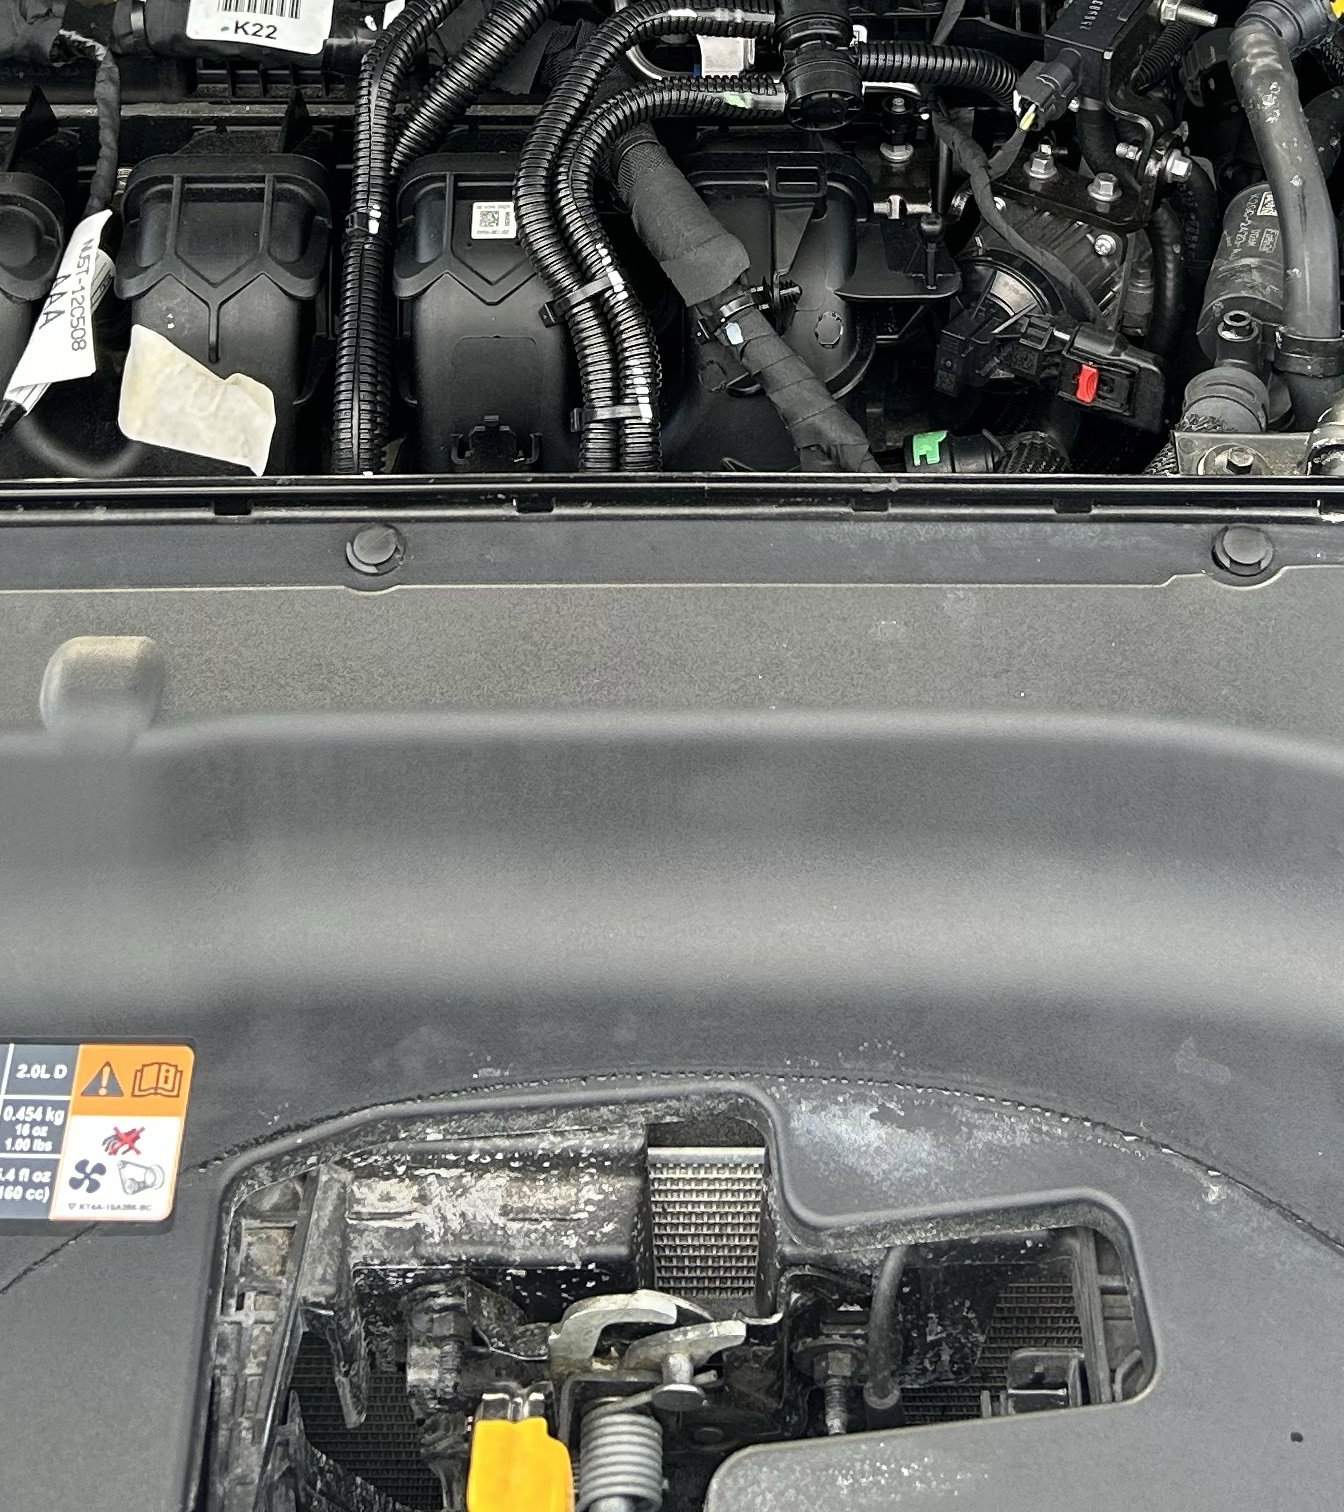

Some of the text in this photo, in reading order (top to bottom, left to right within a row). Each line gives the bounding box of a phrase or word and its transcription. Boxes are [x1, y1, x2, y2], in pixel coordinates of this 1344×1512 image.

[234, 20, 278, 40] K22
[70, 238, 95, 352] NU5T-12C508
[16, 1063, 68, 1079] 2.0L D
[3, 1106, 65, 1125] 0.454 kg
[14, 1123, 49, 1137] 16 oz
[5, 1138, 53, 1152] 1.00 lbs
[18, 1168, 30, 1182] fl
[32, 1171, 52, 1183] oz
[25, 1186, 51, 1203] cc)
